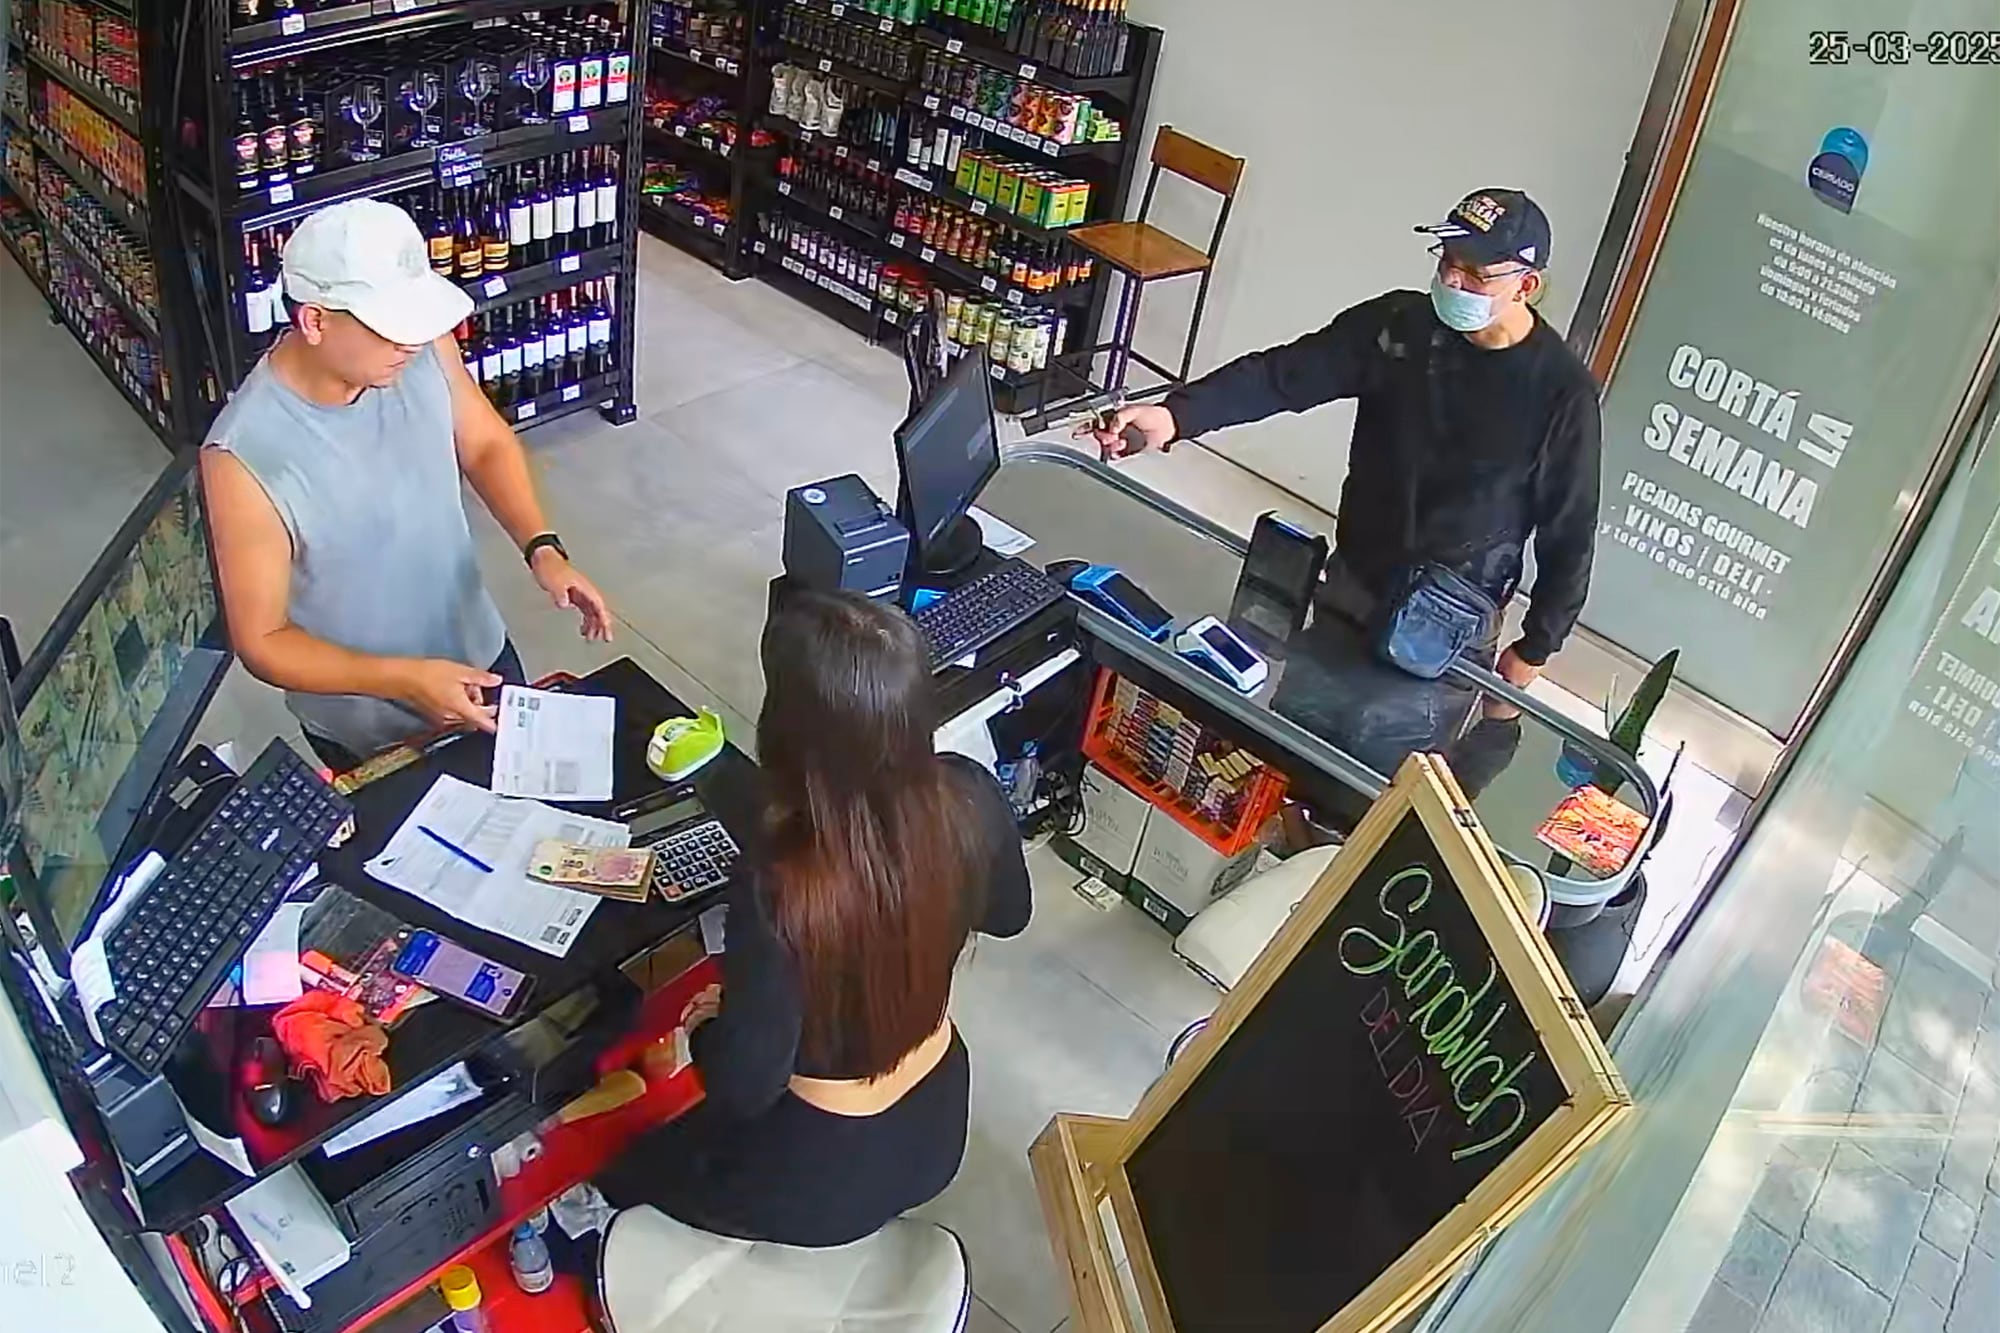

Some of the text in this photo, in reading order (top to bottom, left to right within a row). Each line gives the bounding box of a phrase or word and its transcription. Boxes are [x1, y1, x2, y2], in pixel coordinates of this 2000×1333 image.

[1668, 345, 1854, 469] CORTÁ LA
[1643, 402, 1818, 529] SEMANA
[1600, 522, 1767, 620] y todo lo que está bien
[1622, 471, 1791, 574] PICADAS GOURMET
[1625, 504, 1695, 556] VINOS
[1712, 554, 1765, 595] DELI
[1338, 863, 1536, 1161] Sandwich
